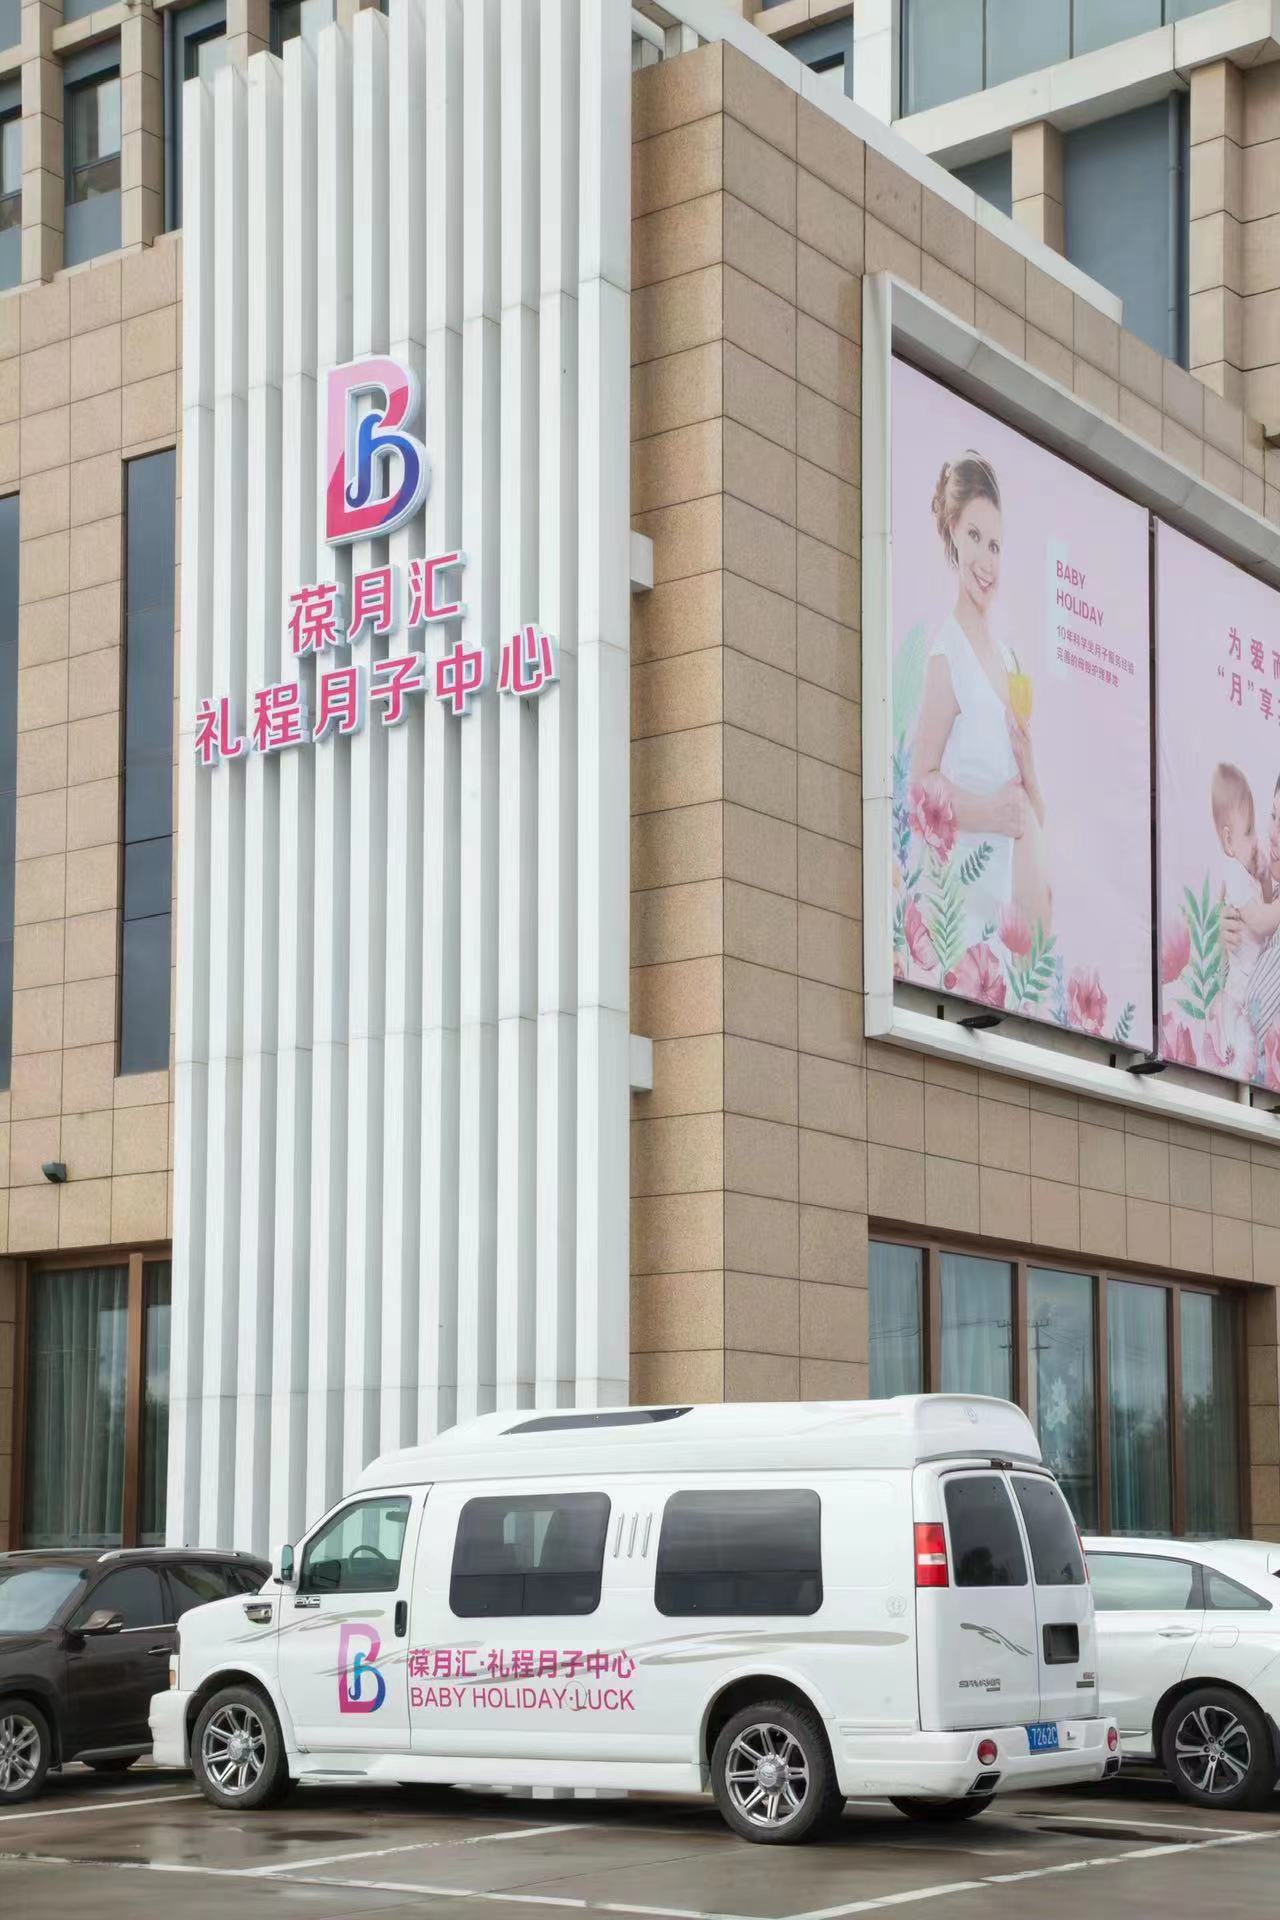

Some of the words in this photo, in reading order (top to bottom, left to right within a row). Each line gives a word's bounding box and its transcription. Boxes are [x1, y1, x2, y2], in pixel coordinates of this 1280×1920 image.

[1056, 560, 1086, 589] BABY
[289, 552, 463, 654] 葆月汇
[1056, 588, 1104, 627] HOLIDAY
[195, 625, 555, 763] 礼程月子中心
[408, 1648, 636, 1679] 葆月汇·礼程月子中心
[411, 1687, 466, 1708] BABY
